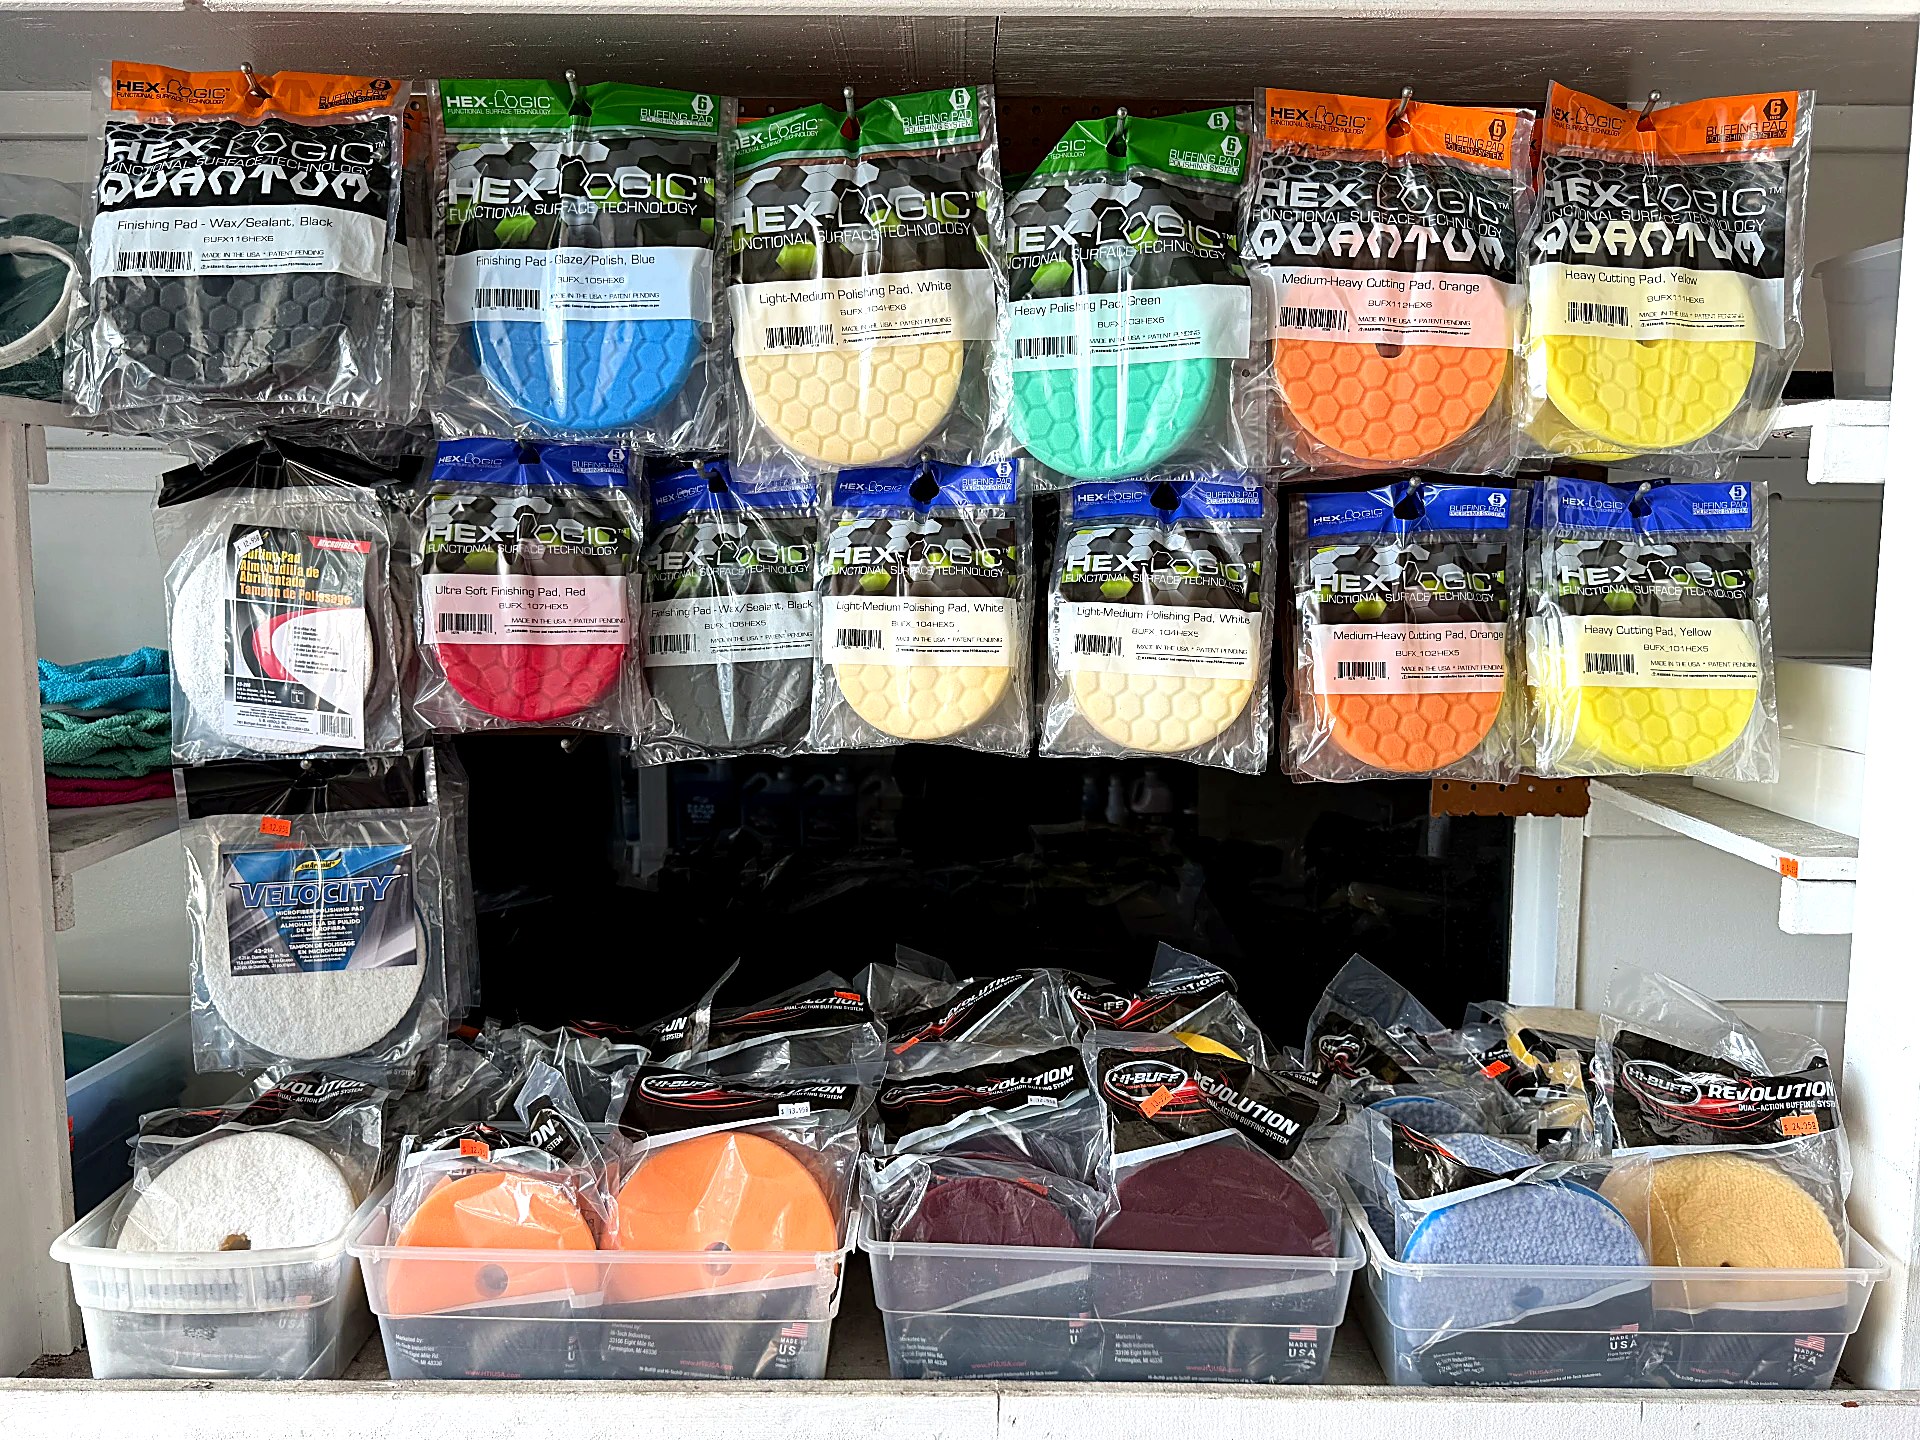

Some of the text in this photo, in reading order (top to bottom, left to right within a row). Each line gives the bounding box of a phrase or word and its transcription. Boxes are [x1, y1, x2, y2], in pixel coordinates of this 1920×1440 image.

[196, 155, 263, 168] SURFACE
[270, 156, 373, 175] TECHNOLOGY
[100, 164, 370, 206] QUANTUM
[450, 204, 530, 221] FUNCTIONAL
[600, 201, 697, 216] TECHNOLOGY
[1253, 209, 1345, 223] FUNCTIONAL
[118, 220, 168, 231] Finishing
[175, 219, 197, 229] Pad
[300, 216, 333, 228] Black
[879, 222, 971, 240] TECHNOLOGY
[1251, 221, 1504, 270] QUANTUM
[1534, 217, 1765, 267] QUANTUM
[1138, 240, 1226, 260] TECHNOLOGY
[476, 256, 521, 268] Finishing
[525, 256, 546, 267] Pad
[631, 255, 655, 264] Blue
[1282, 273, 1363, 290] Medium-Heavy
[1367, 277, 1405, 291] Cutting
[1439, 281, 1479, 294] Orange
[1566, 270, 1595, 284] Heavy
[1599, 272, 1635, 285] Cutting
[760, 290, 834, 306] Light-Medium
[917, 281, 951, 292] White
[1014, 303, 1046, 317] Heavy
[1128, 296, 1161, 306] Green
[428, 544, 493, 553] FUNCTIONAL
[549, 545, 619, 555] TECHNOLOGY
[281, 551, 301, 564] Pad
[306, 566, 319, 578] de
[938, 566, 1004, 578] TECHNOLOGY
[1065, 573, 1128, 583] FUNCTIONAL
[283, 588, 296, 599] de
[436, 586, 462, 595] Ultra
[466, 586, 487, 596] Soft
[492, 587, 534, 598] Finishing
[566, 588, 586, 597] Red
[1563, 584, 1746, 599] FUNCTIONAL SURFACE TECHNOLOGY
[788, 600, 813, 609] Black
[974, 603, 1004, 613] White
[1077, 607, 1143, 619] Light-Medium
[1147, 610, 1191, 623] Polishing
[1220, 614, 1250, 625] White
[1334, 630, 1405, 641] Medium-Heavy
[1470, 630, 1503, 641] Orange
[1584, 624, 1613, 636] Heavy
[1616, 626, 1653, 637] Cutting
[1680, 627, 1712, 637] Yellow
[230, 874, 401, 908] VELOCITY
[1629, 1067, 1693, 1095] HI-BUFF
[1264, 1129, 1289, 1146] SYSTEM
[1288, 1349, 1316, 1358] USA
